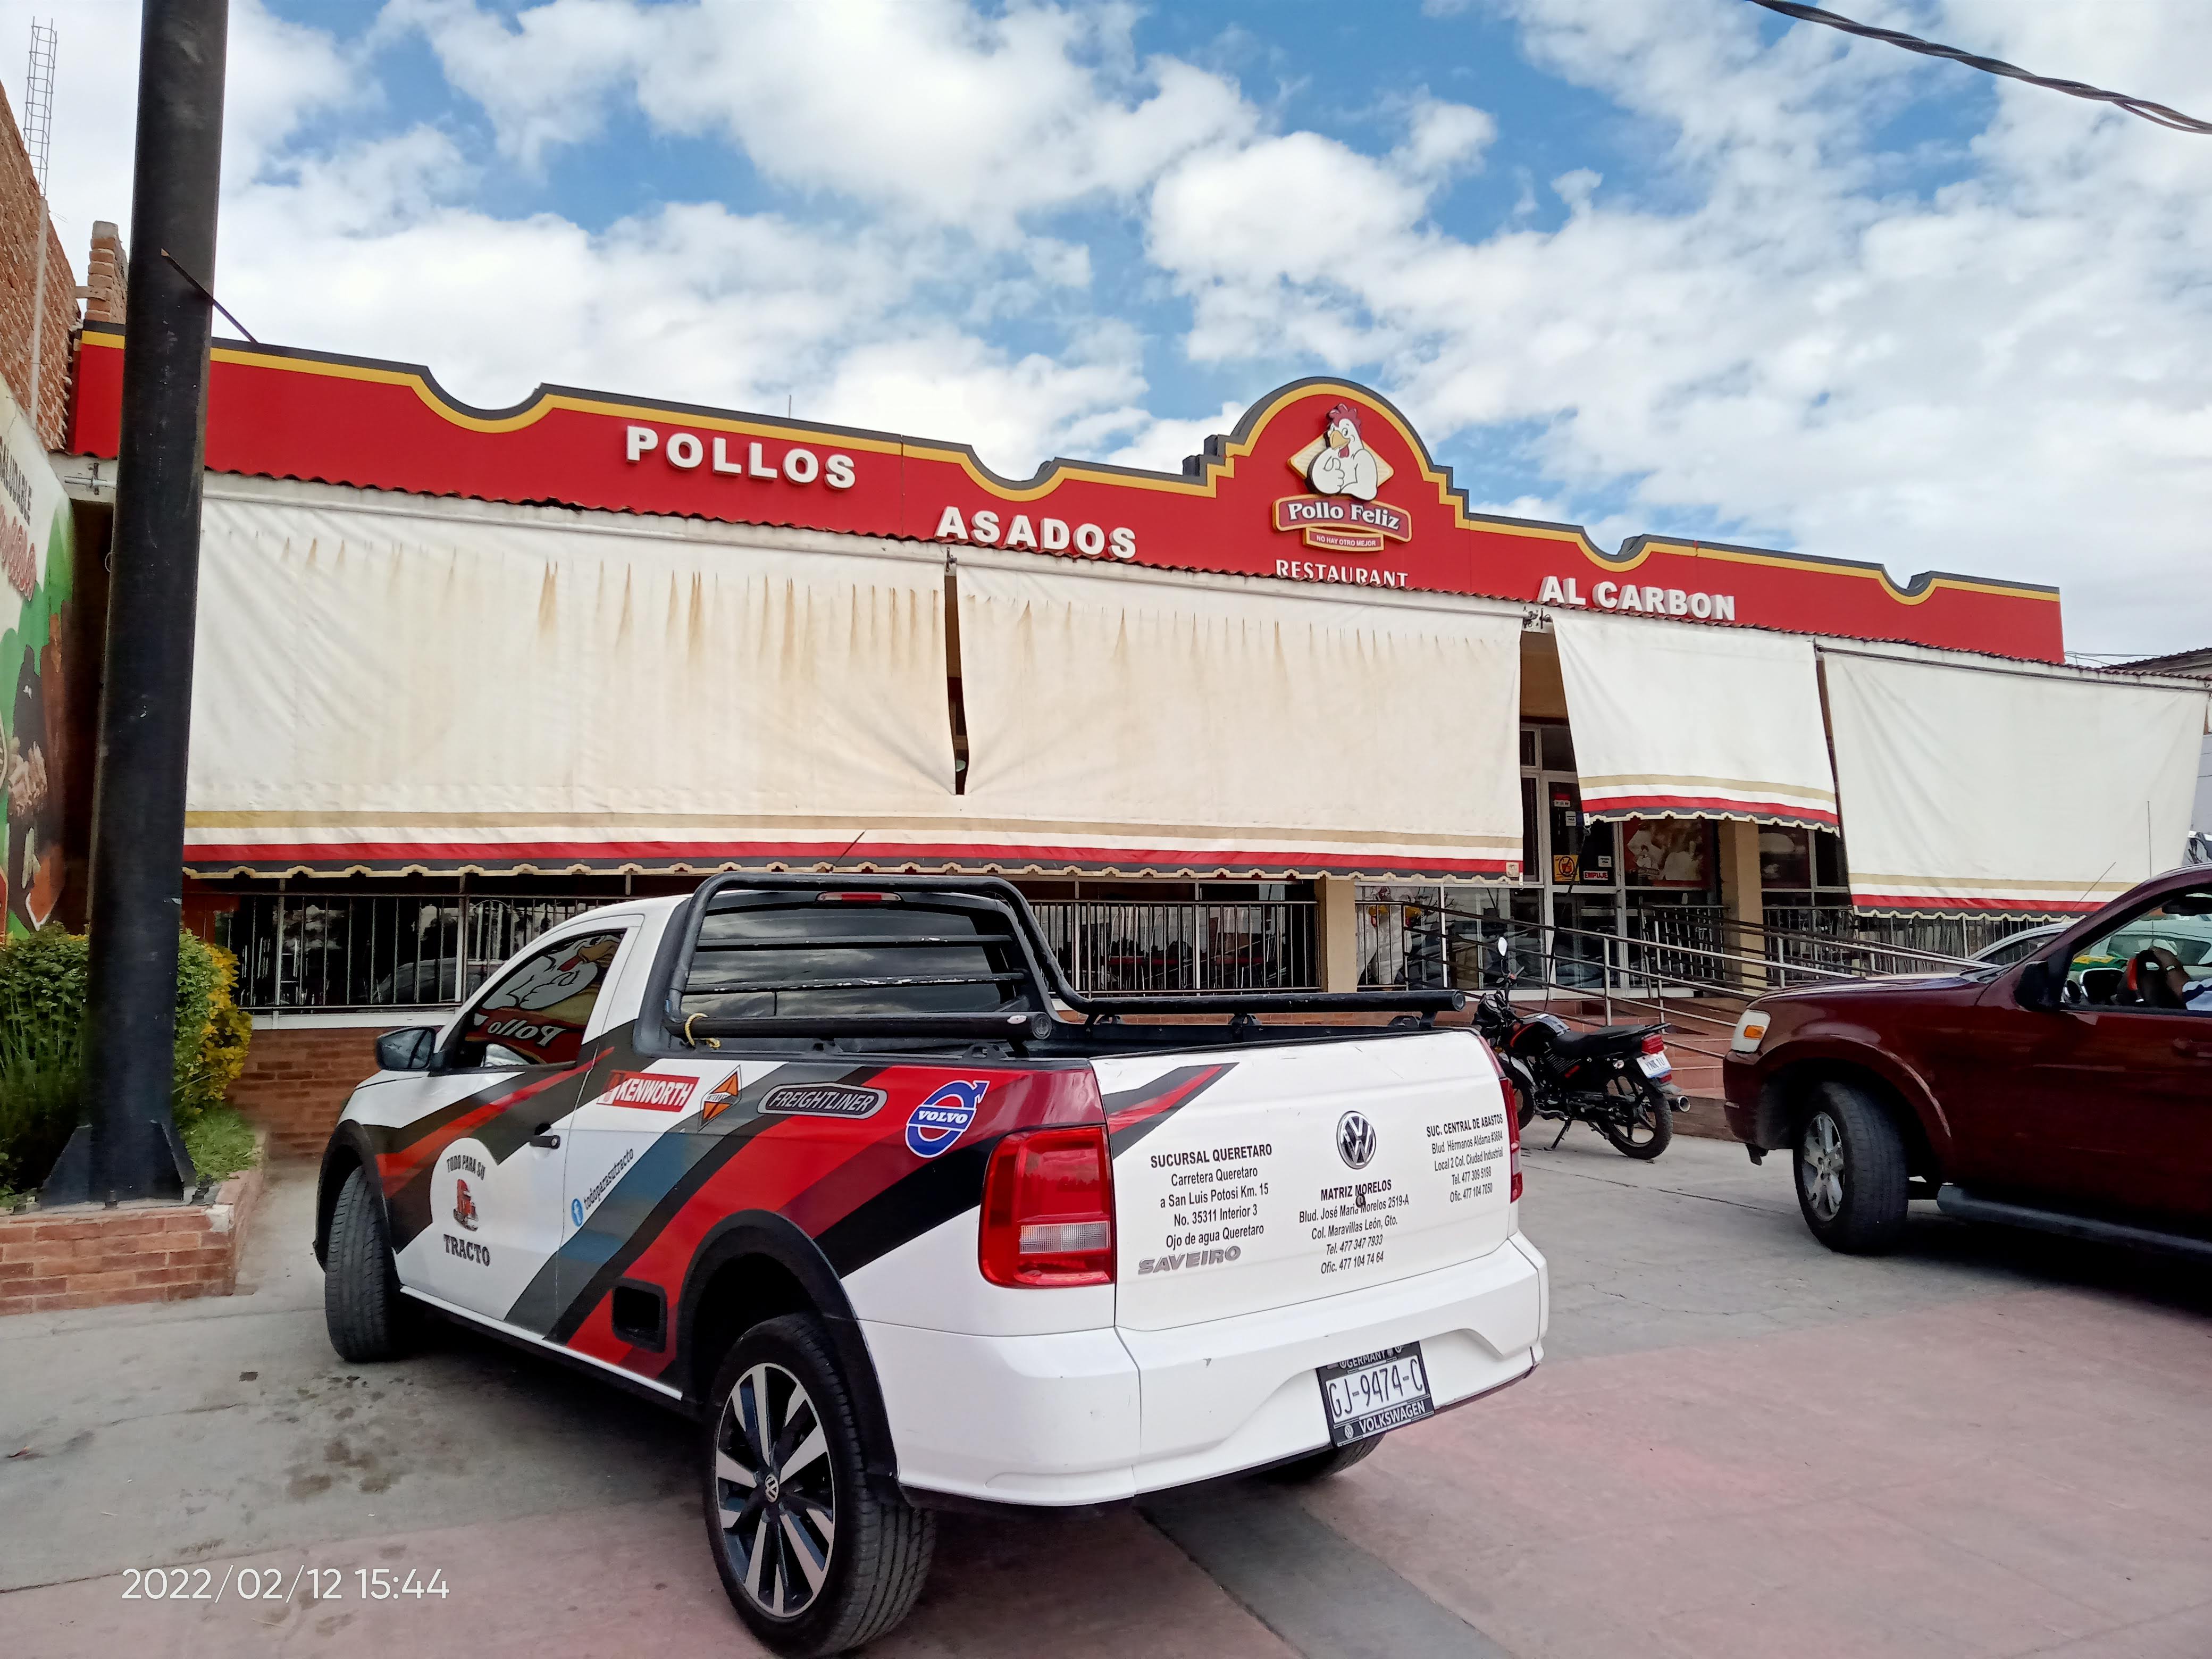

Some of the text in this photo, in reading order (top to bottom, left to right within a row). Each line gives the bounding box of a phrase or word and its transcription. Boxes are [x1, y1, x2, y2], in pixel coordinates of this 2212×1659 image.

[626, 425, 856, 490] POLLOS
[1287, 501, 1400, 530] Pollo Feliz
[934, 505, 1137, 560] ASADOS
[1316, 534, 1326, 543] NO
[1326, 537, 1338, 545] HAY
[1339, 538, 1355, 547] OTRO
[1276, 559, 1408, 586] RESTAURANT
[1537, 576, 1735, 621] AL CARBON
[615, 1078, 694, 1107] KENWORTH
[770, 1089, 875, 1112] FREIGHTLINER
[918, 1110, 968, 1125] VOLVO
[1426, 1113, 1503, 1137] SUC. CENTRAL DE ABASTOS
[1474, 1135, 1490, 1146] Aldama
[447, 1154, 486, 1180] TODO PARA SU
[1151, 1144, 1272, 1168] SUCURSAL QUERETARO
[1435, 1146, 1503, 1171] Local 2 Col. Ciudad Industrial
[584, 1149, 633, 1210] todoparasutracto
[1171, 1167, 1258, 1186] Carretera Queretaro
[1452, 1174, 1461, 1185] Tel.
[1462, 1171, 1471, 1183] 477
[1471, 1169, 1480, 1181] 309
[1160, 1183, 1269, 1208] a San Luis Potosi Km. 15
[1321, 1179, 1392, 1201] MATRIZ MORELOS
[1450, 1190, 1462, 1203] Ofic.
[1463, 1187, 1472, 1200] 477
[1473, 1185, 1481, 1197] 104
[1174, 1203, 1258, 1227] No. 35311 Interior 3
[1321, 1205, 1338, 1220] José
[1388, 1194, 1409, 1209] 2519-A
[1166, 1225, 1264, 1251] Ojo de agua Queretaro
[1312, 1215, 1398, 1239] Col. Maravillas León, Gto.
[443, 1234, 490, 1267] TRACTO
[1327, 1234, 1383, 1255] Tel. 477 347 7933
[1138, 1245, 1241, 1275] SAVEIRO
[1321, 1251, 1384, 1274] Ofic. 477 104 74 64
[1329, 1359, 1423, 1418] GJ-9474-C
[1359, 1401, 1426, 1434] VOLKSWAGEN
